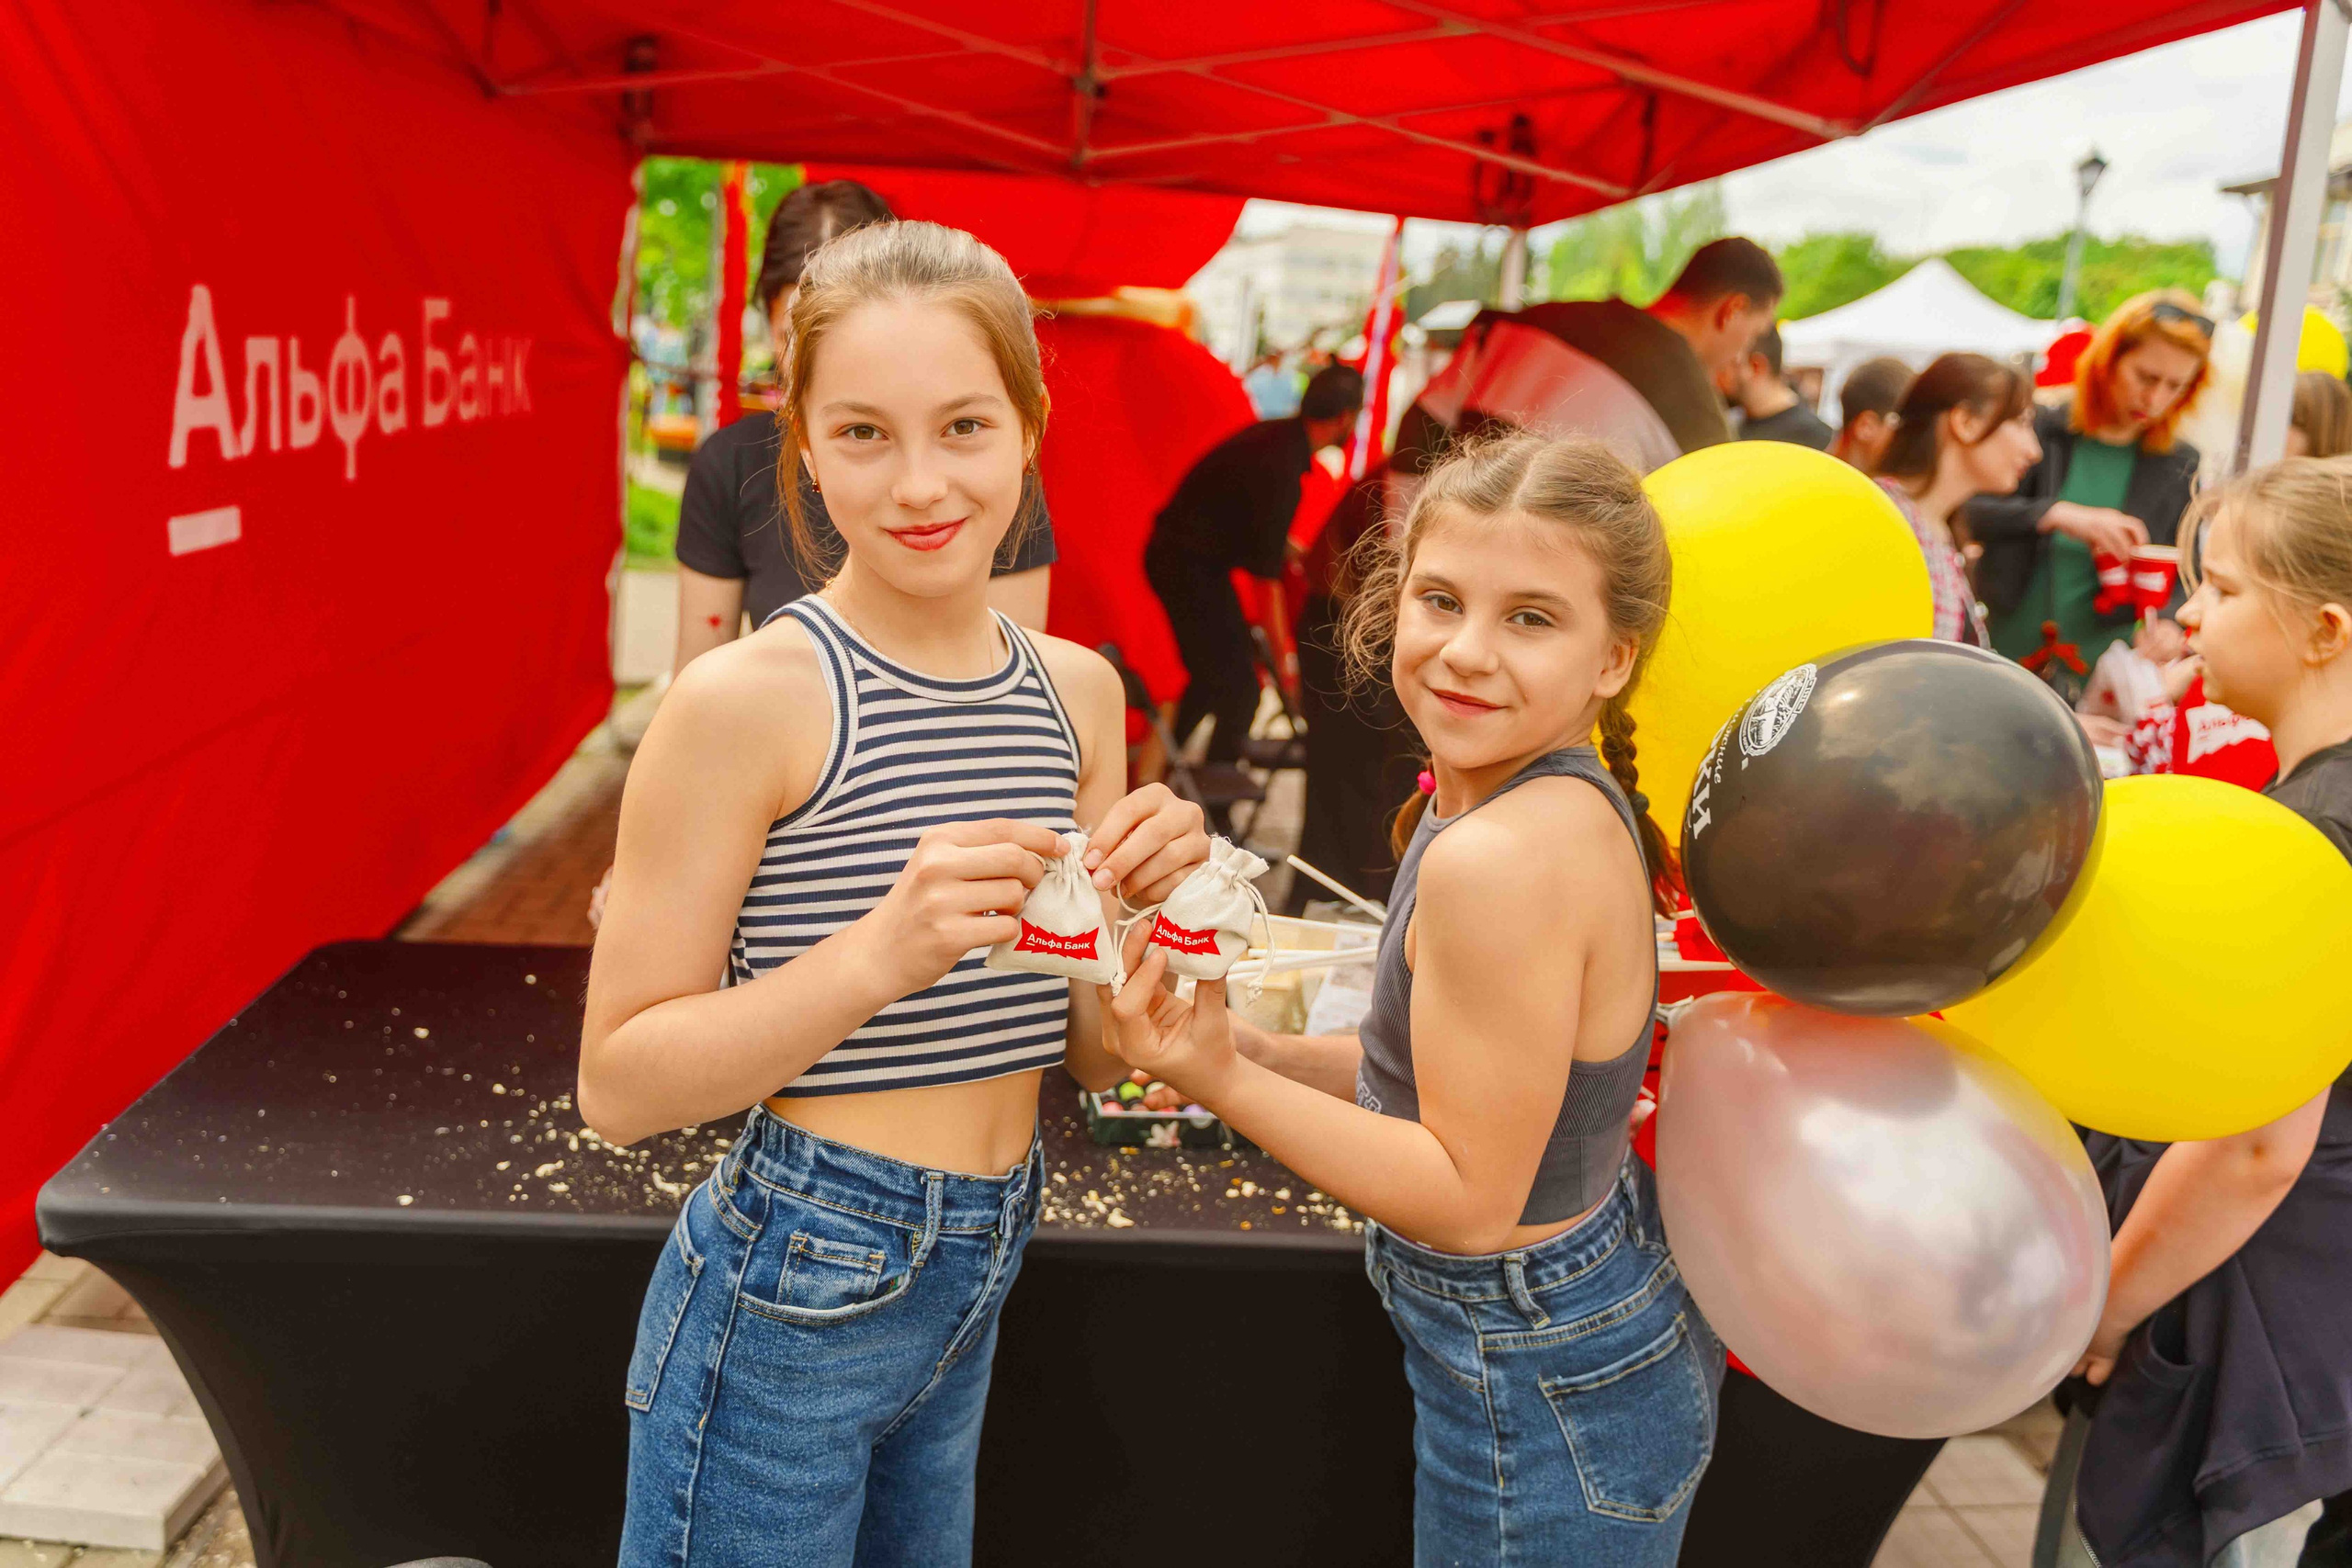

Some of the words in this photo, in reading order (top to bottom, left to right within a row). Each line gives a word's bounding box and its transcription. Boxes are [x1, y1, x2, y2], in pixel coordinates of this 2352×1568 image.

[168, 283, 407, 481] Альфа
[423, 296, 533, 428] Банк
[1026, 932, 1062, 949] Альфа
[1064, 942, 1091, 950] Банк
[1157, 924, 1183, 943] Альфа
[1184, 936, 1210, 946] Банк
